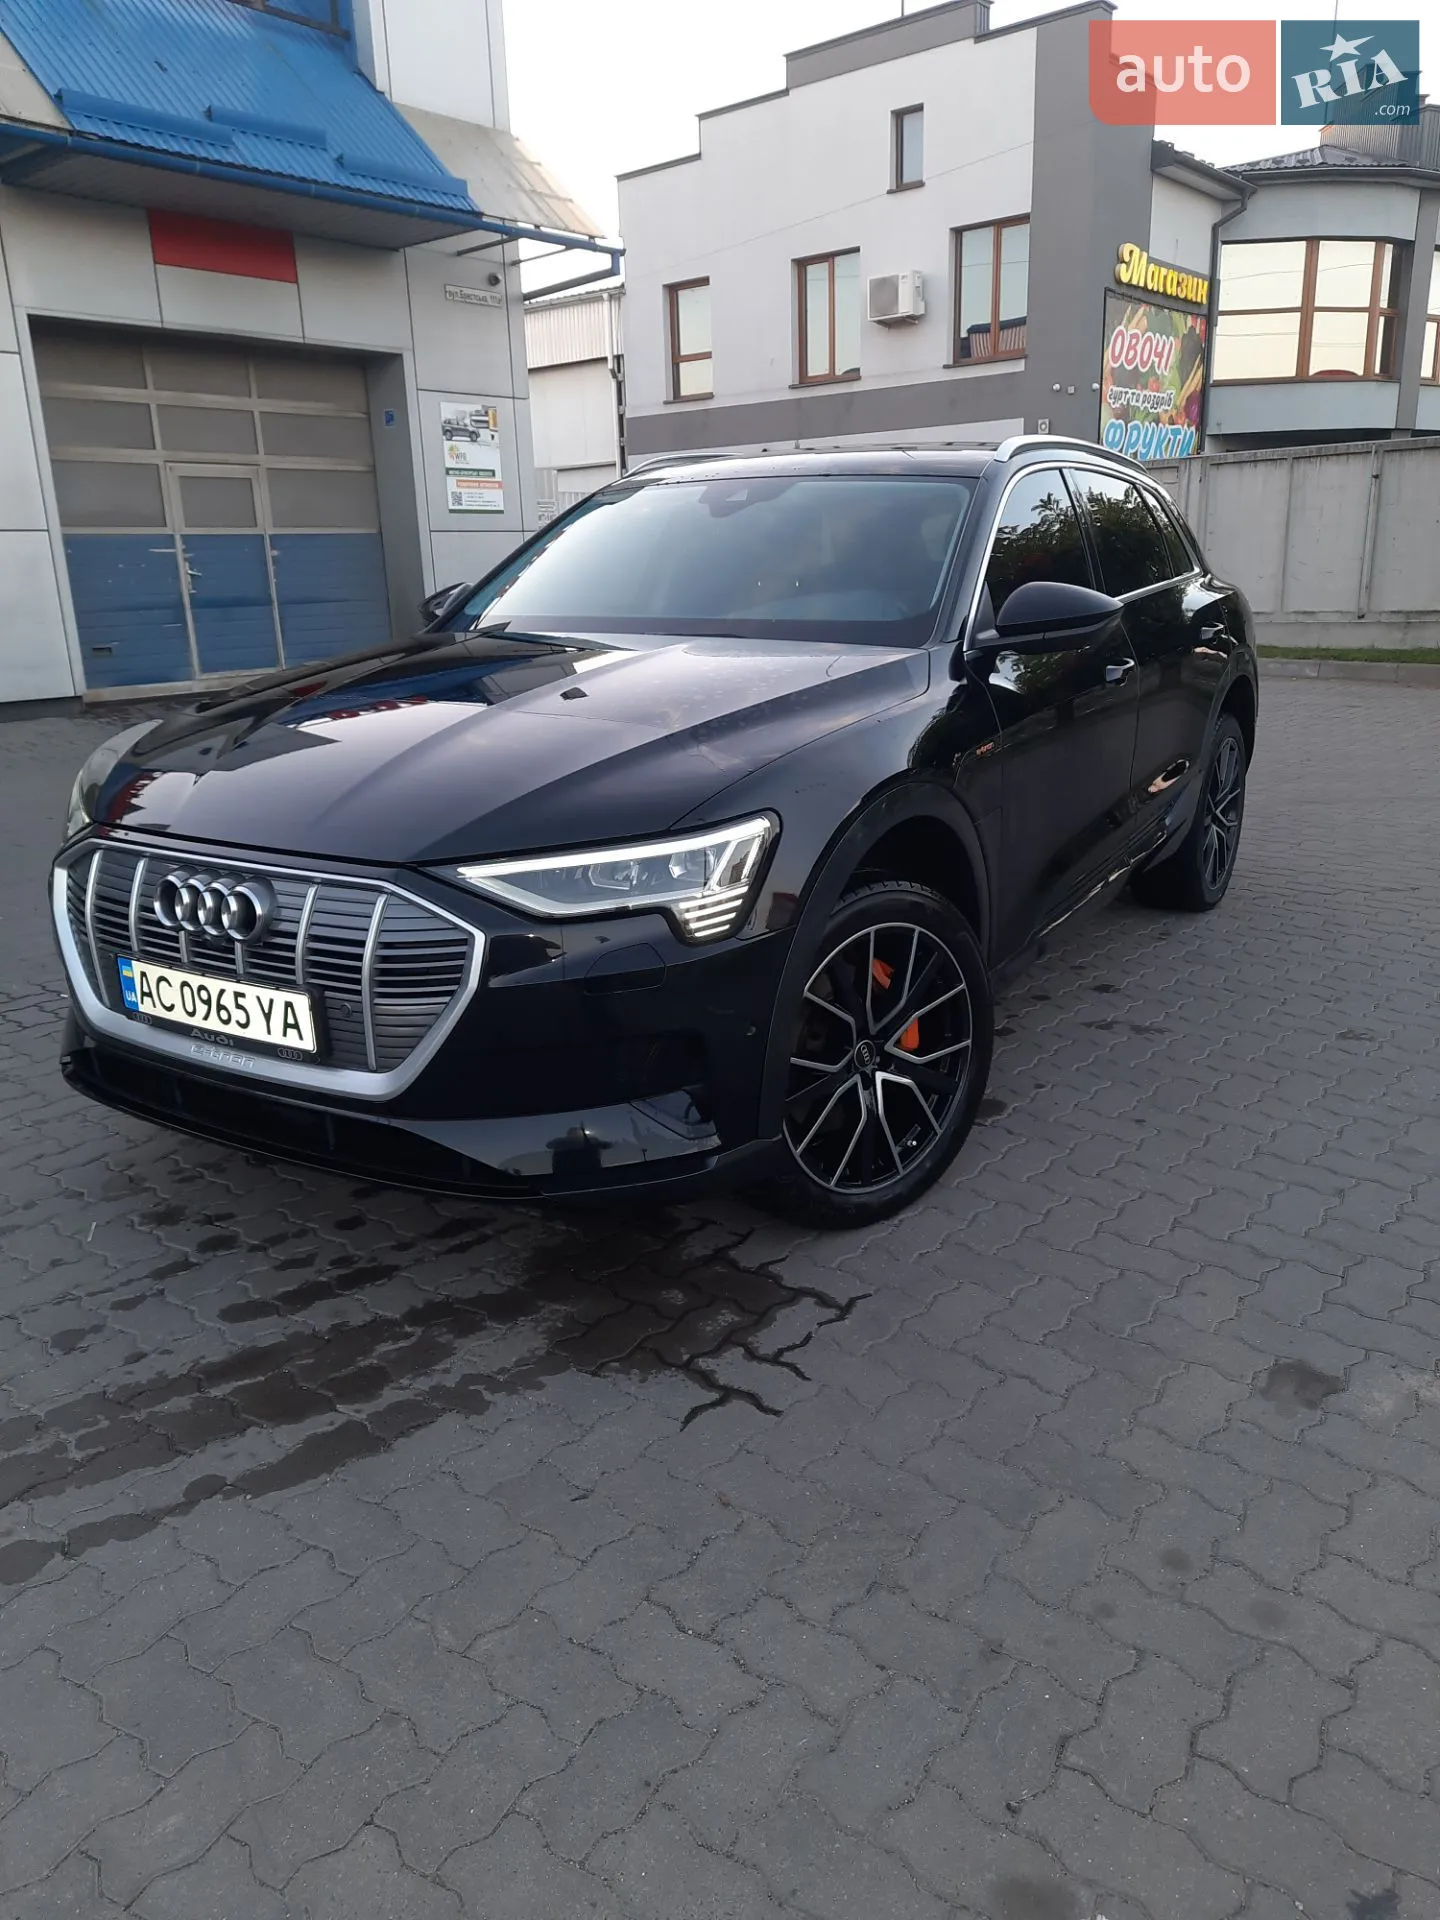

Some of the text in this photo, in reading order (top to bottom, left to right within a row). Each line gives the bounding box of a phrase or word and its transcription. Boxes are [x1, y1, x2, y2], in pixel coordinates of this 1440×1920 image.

[1118, 242, 1208, 305] Магазин
[1110, 327, 1174, 375] ОВОЧІ
[1103, 419, 1196, 461] ФРУКТИ
[125, 990, 137, 1003] UA
[139, 970, 304, 1041] AC 0965 YA
